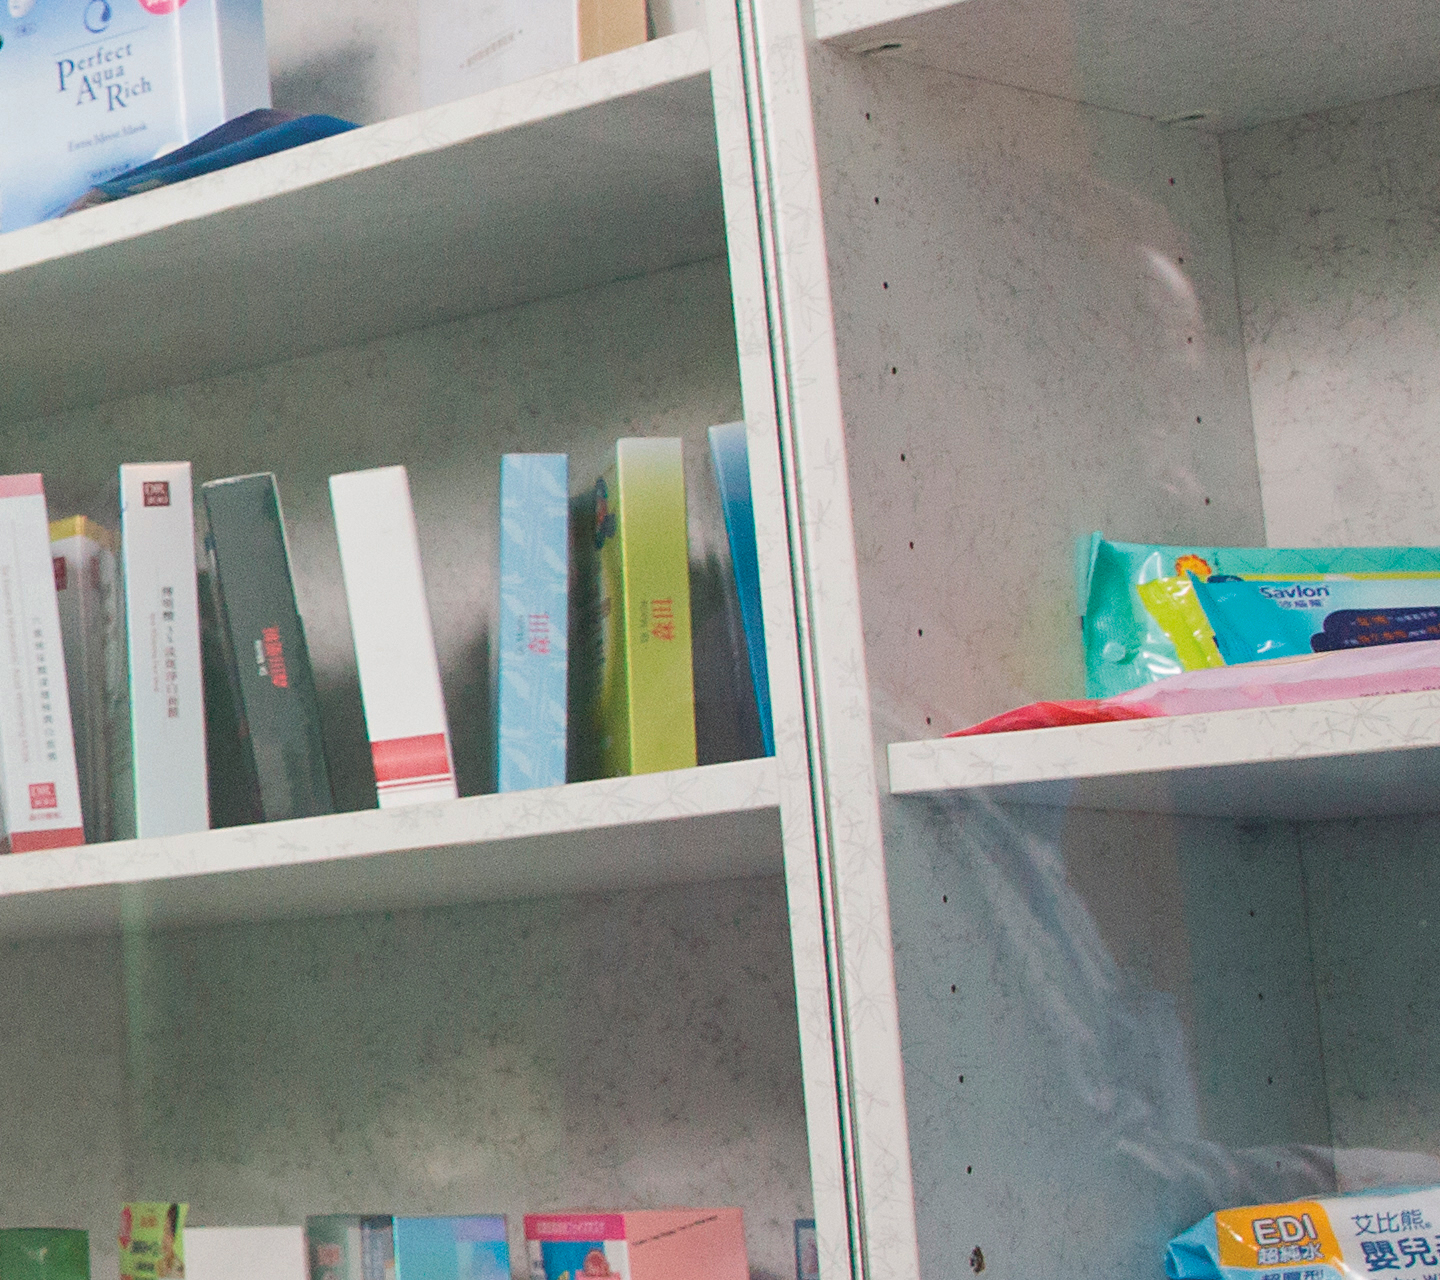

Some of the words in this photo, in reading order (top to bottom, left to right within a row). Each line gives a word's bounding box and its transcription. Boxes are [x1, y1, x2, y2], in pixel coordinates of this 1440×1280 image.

[56, 43, 133, 92] Perfect
[76, 64, 126, 106] Aqua
[106, 77, 152, 112] Rich
[1259, 584, 1329, 600] Savlon
[1252, 1213, 1318, 1246] EDI
[1351, 1209, 1428, 1236] 艾比熊
[1258, 1242, 1325, 1266] 超純水
[1360, 1234, 1440, 1272] 嬰兒
